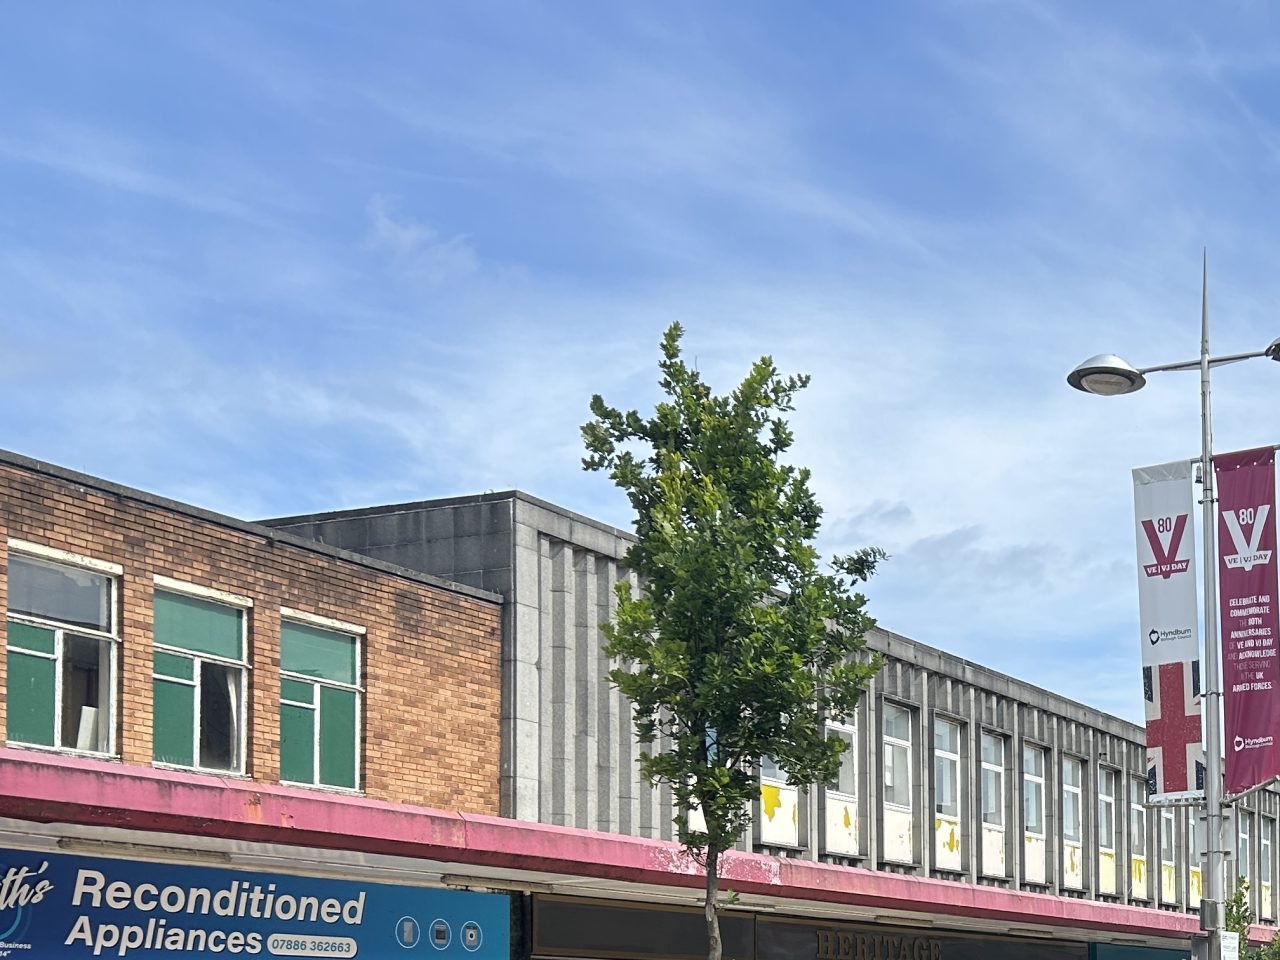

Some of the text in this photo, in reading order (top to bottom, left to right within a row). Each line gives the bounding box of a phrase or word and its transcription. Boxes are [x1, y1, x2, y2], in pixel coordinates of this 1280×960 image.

[1157, 516, 1172, 534] 80
[1239, 507, 1254, 525] 80
[1227, 557, 1238, 565] VE
[1253, 553, 1269, 563] DAY
[1146, 566, 1158, 575] VE
[1161, 564, 1171, 572] VJ
[1171, 562, 1188, 571] DAY
[1236, 640, 1245, 650] VE
[1262, 637, 1274, 647] DAY
[72, 868, 366, 925] Reconditioned
[64, 915, 351, 957] Appliances 07886 362663
